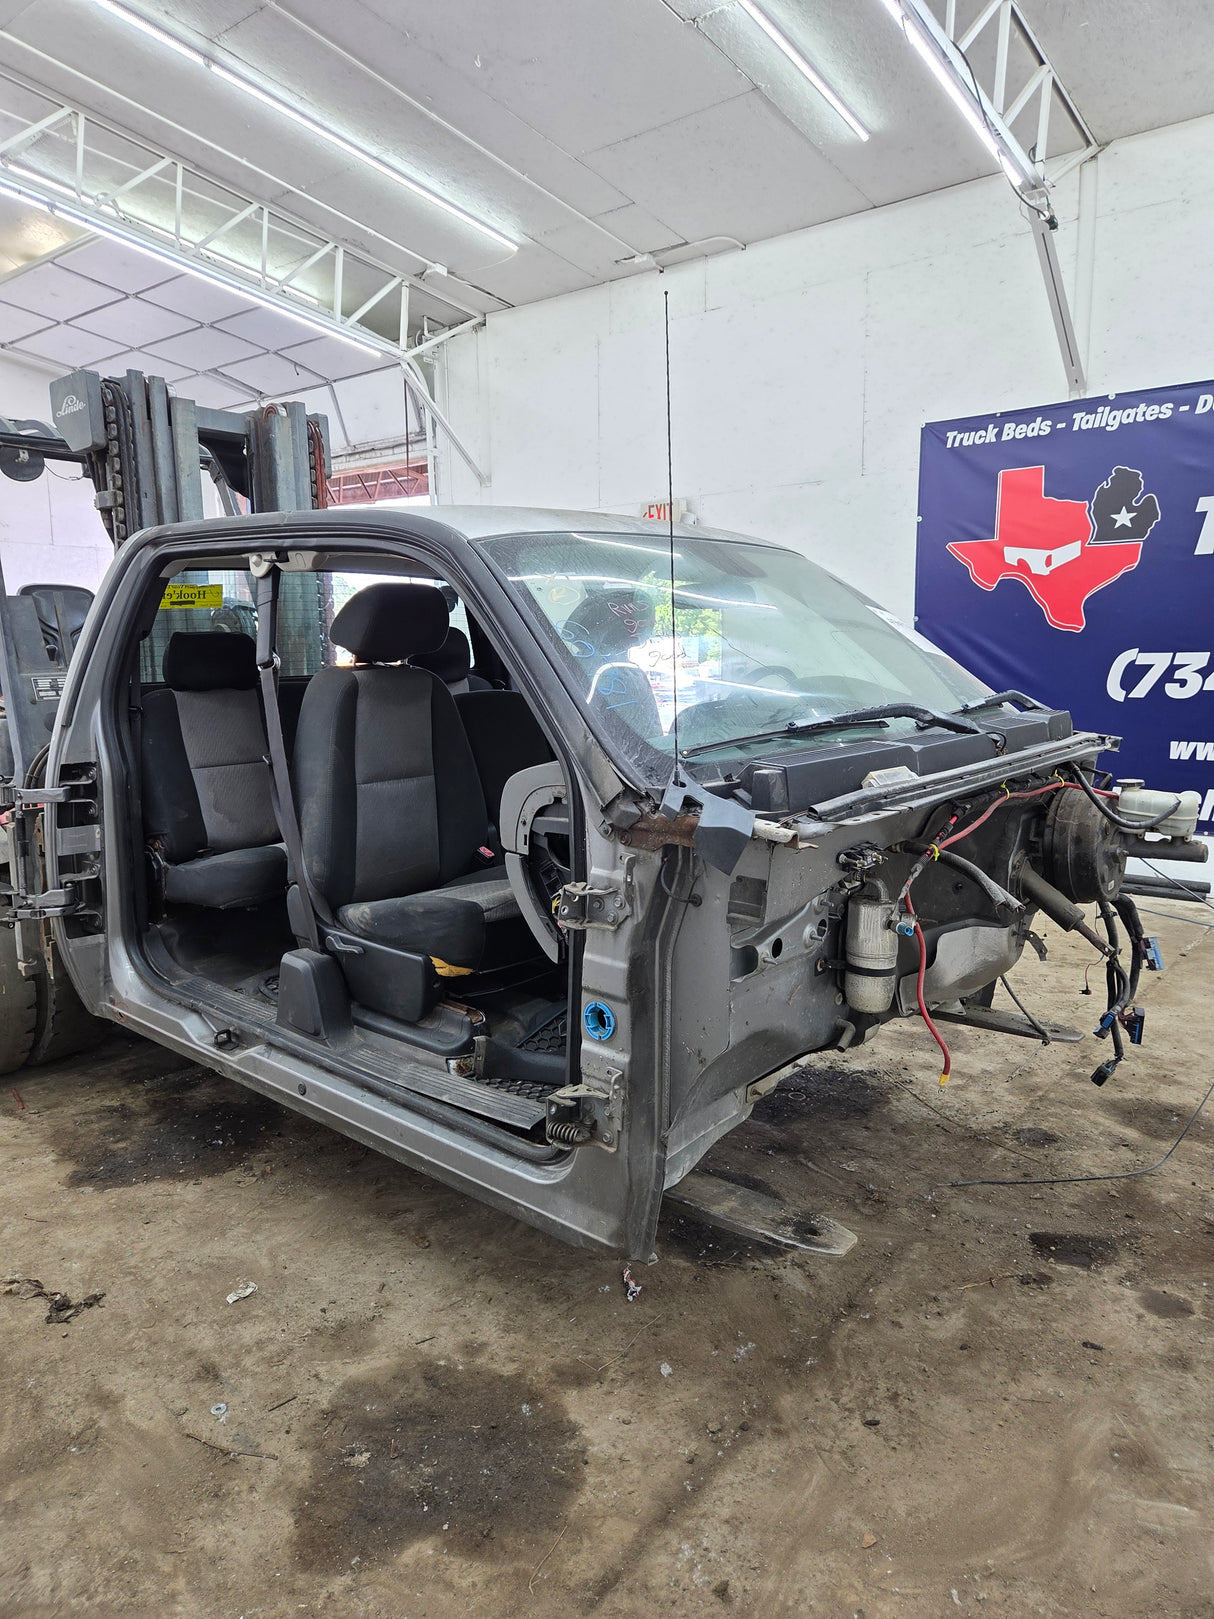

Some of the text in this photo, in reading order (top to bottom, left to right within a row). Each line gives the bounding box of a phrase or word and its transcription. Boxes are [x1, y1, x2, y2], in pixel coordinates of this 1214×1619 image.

[56, 395, 86, 418] Linde
[946, 424, 999, 448] Truck
[1001, 417, 1052, 441] Beds
[1072, 403, 1174, 431] Tailgates
[1194, 394, 1214, 414] D
[1106, 648, 1214, 702] (73
